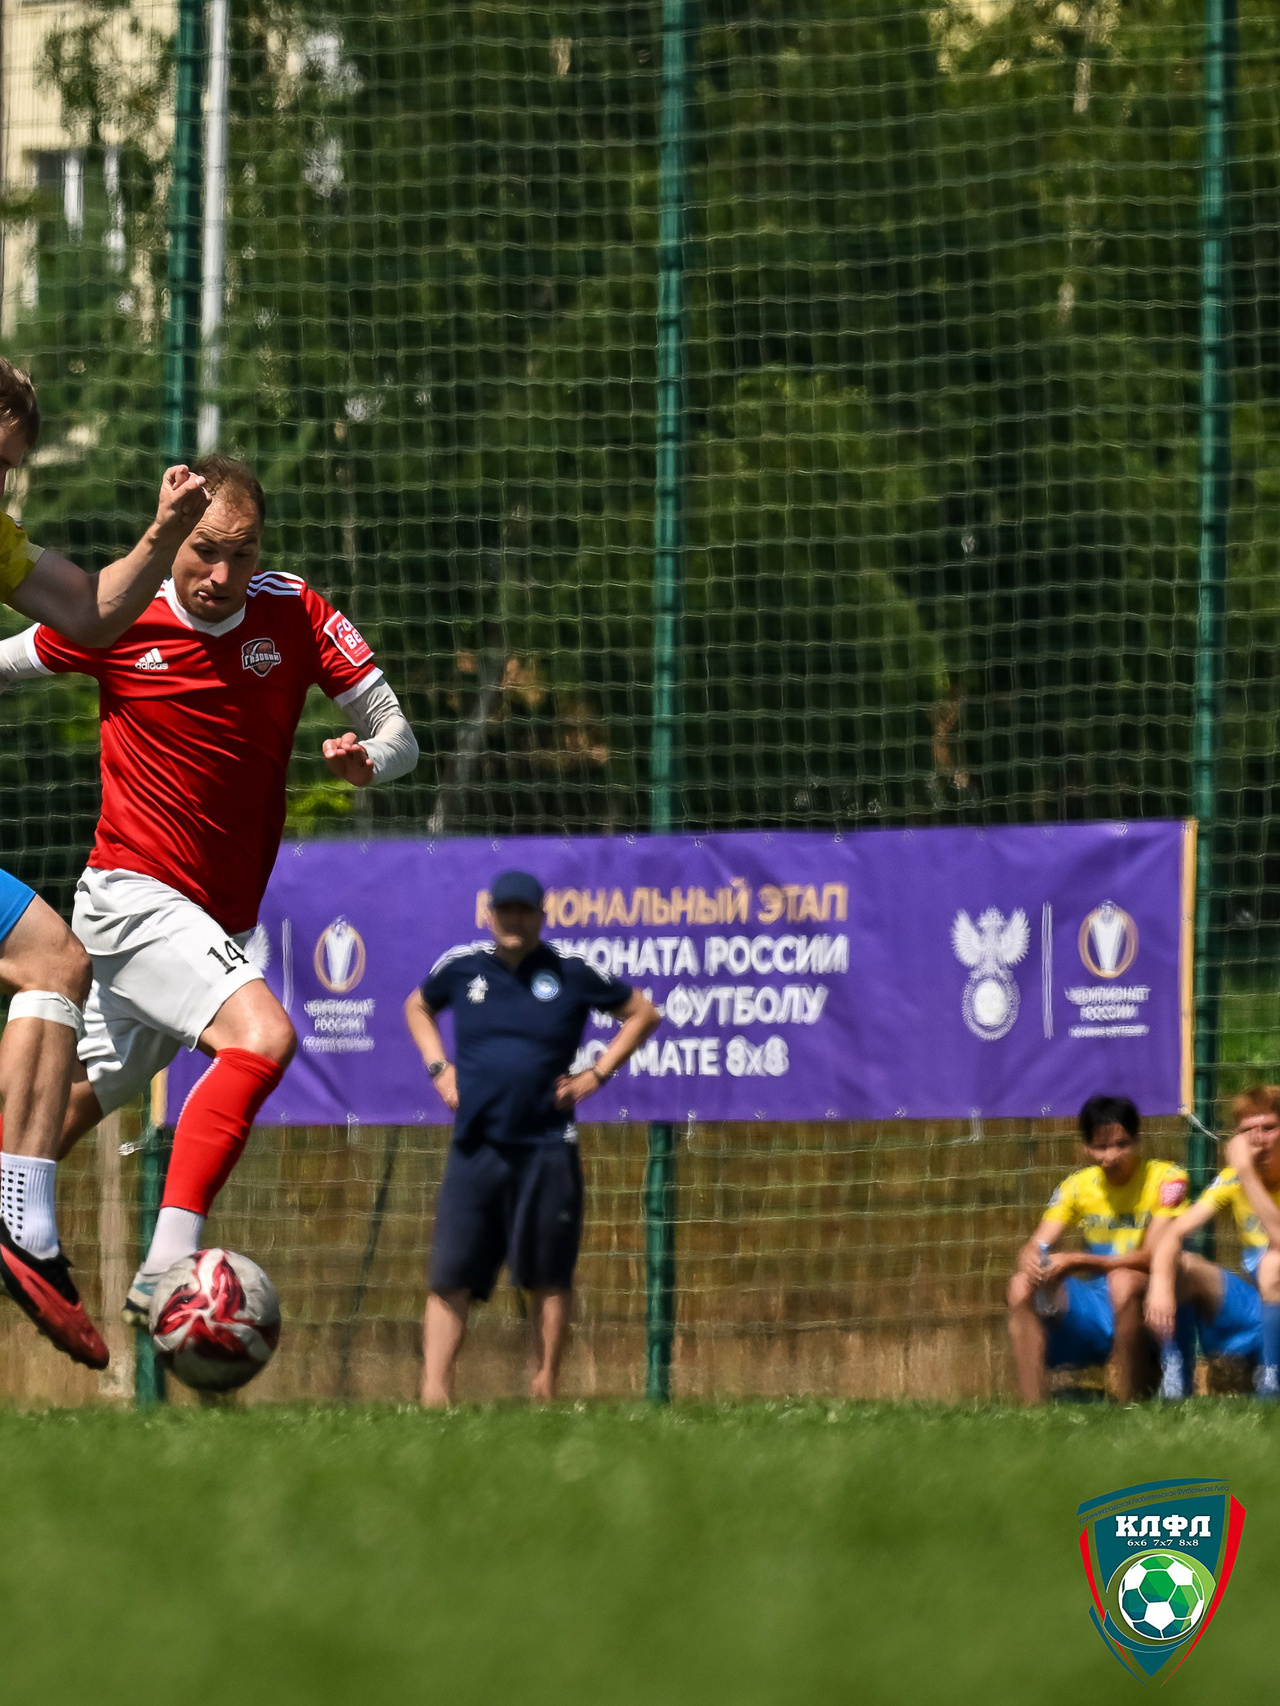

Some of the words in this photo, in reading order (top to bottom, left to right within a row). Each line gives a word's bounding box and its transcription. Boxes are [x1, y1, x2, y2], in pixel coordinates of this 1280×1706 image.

[134, 661, 169, 670] adidas
[476, 876, 750, 929] ИОНАЛЬНЫЙ
[757, 882, 849, 925] ЭТАП
[207, 940, 249, 974] 14
[704, 934, 849, 976] РОССИИ
